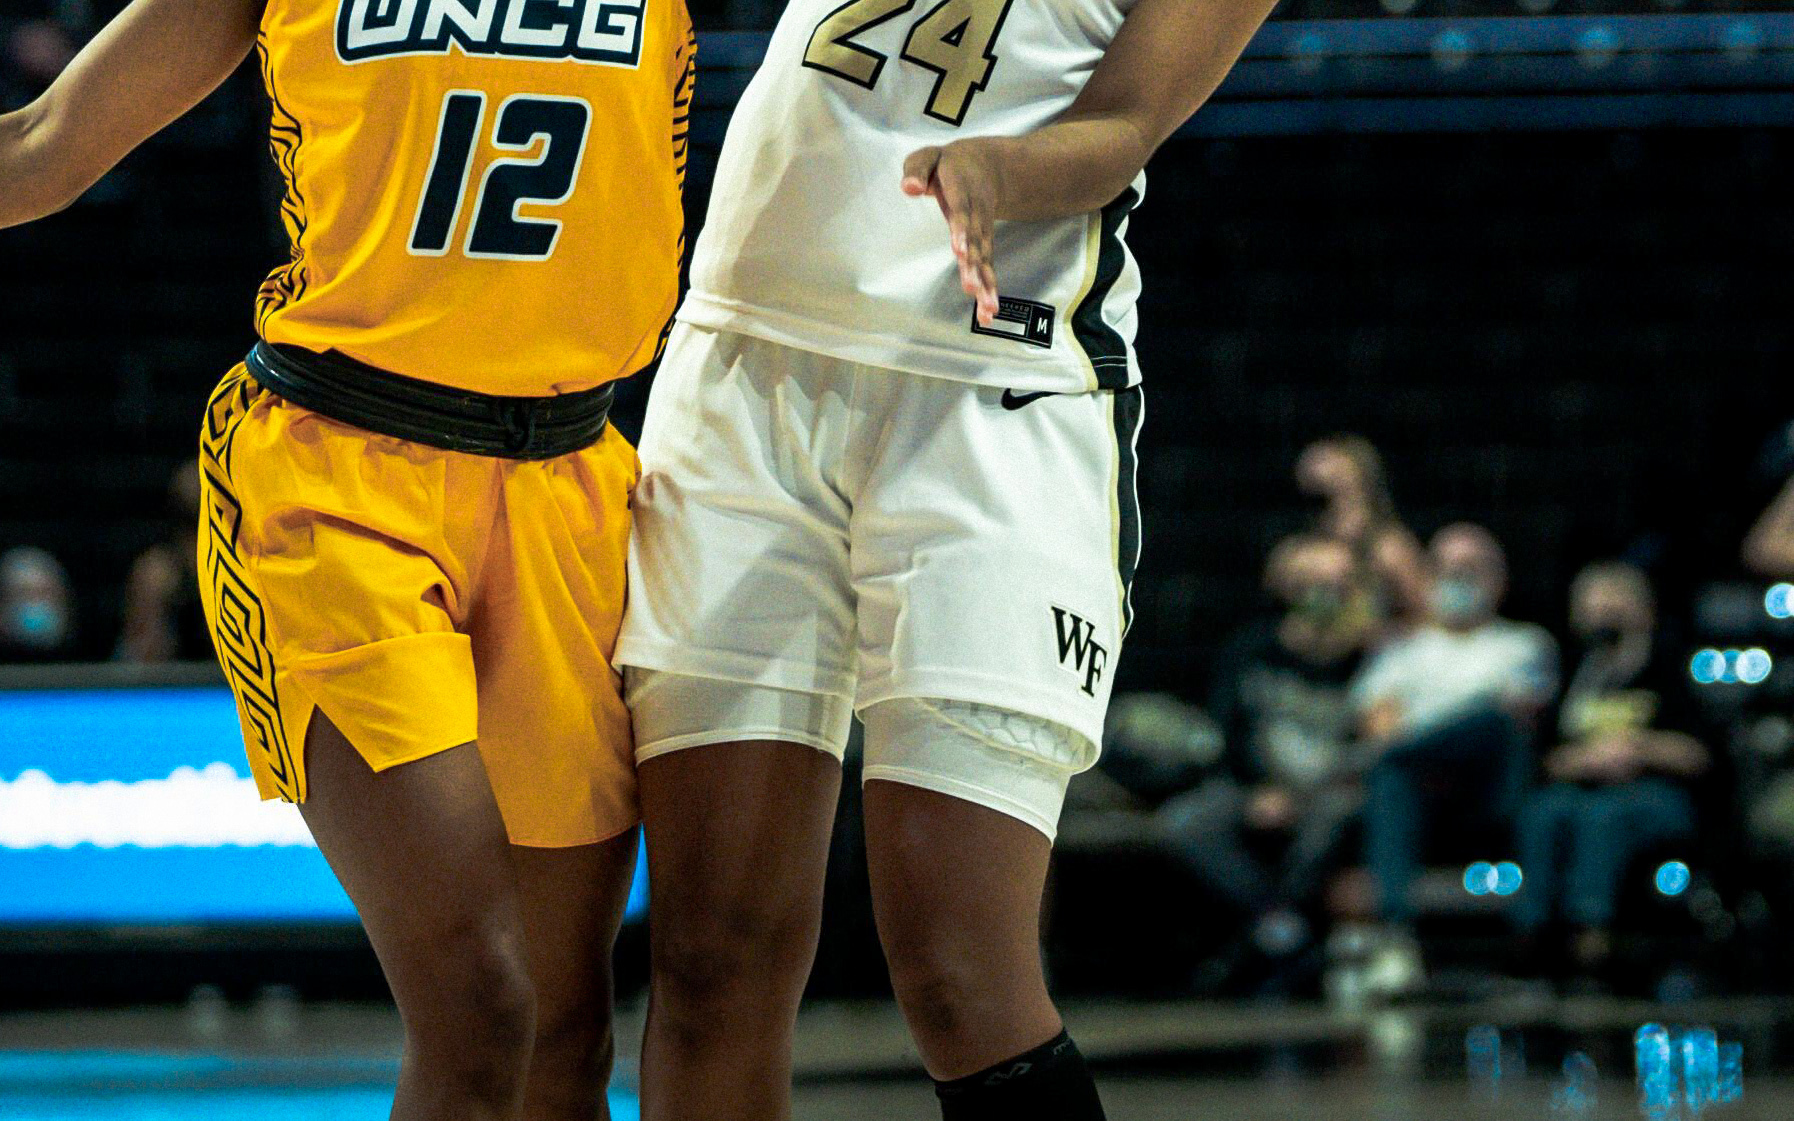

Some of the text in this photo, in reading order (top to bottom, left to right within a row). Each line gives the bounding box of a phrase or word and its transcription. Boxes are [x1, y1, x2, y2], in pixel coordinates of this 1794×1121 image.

[406, 90, 593, 262] 12
[1037, 317, 1048, 335] M
[1051, 605, 1107, 697] WF
